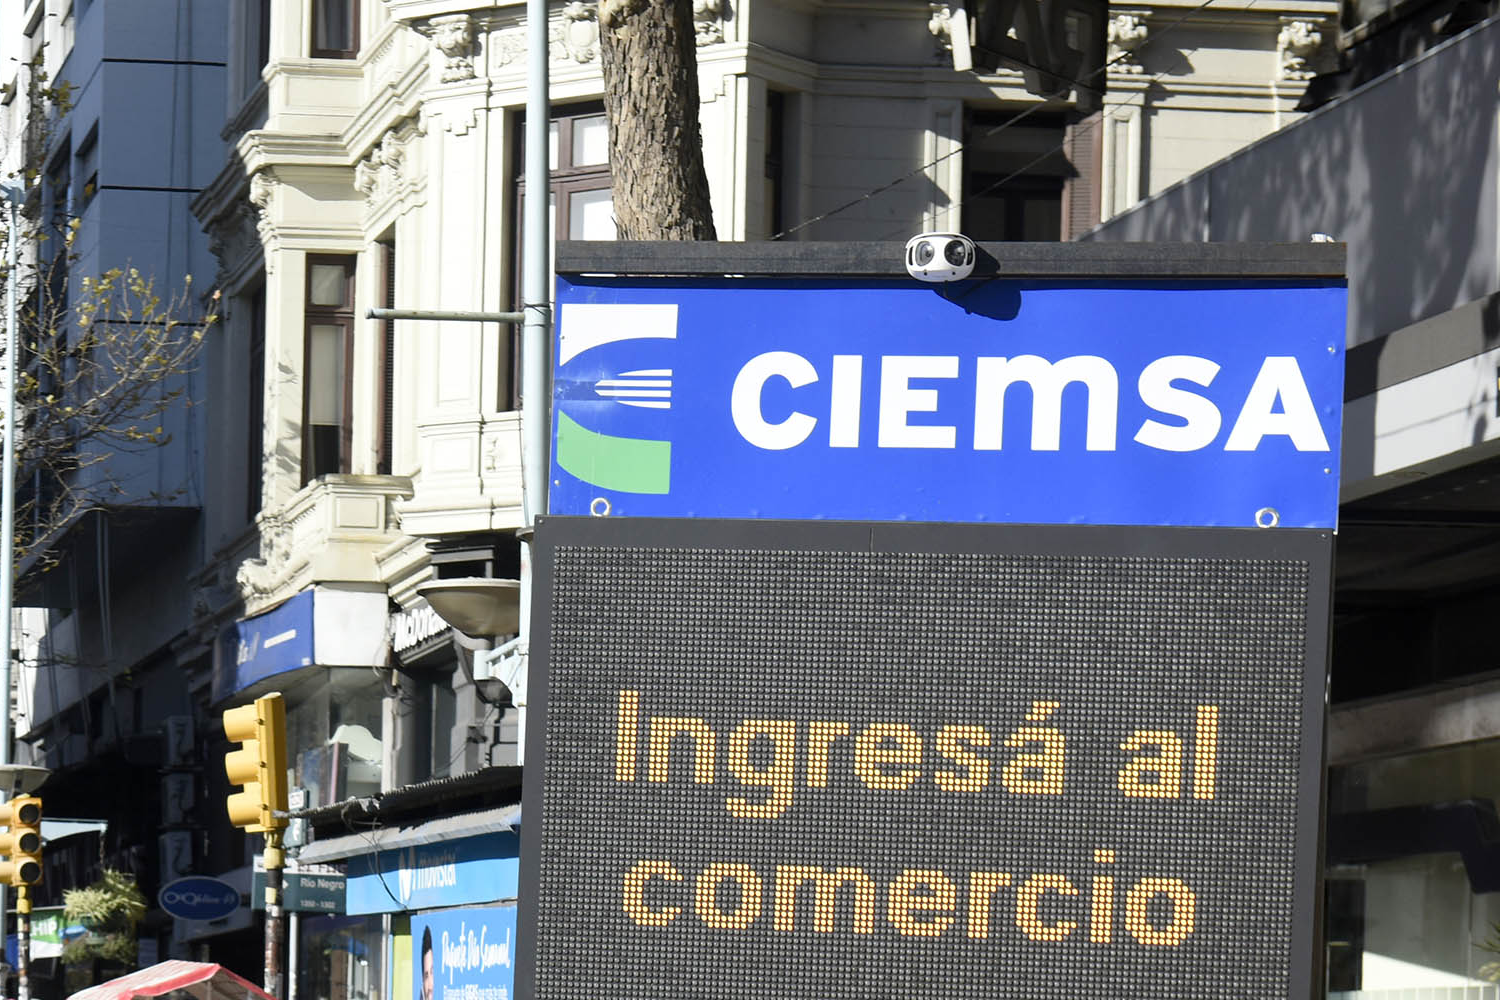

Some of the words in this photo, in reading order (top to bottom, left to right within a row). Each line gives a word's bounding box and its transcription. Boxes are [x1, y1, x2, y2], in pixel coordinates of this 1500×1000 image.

[615, 690, 1066, 819] Ingresá
[1117, 704, 1219, 800] al
[317, 879, 345, 891] Negro
[623, 849, 1197, 946] comercio
